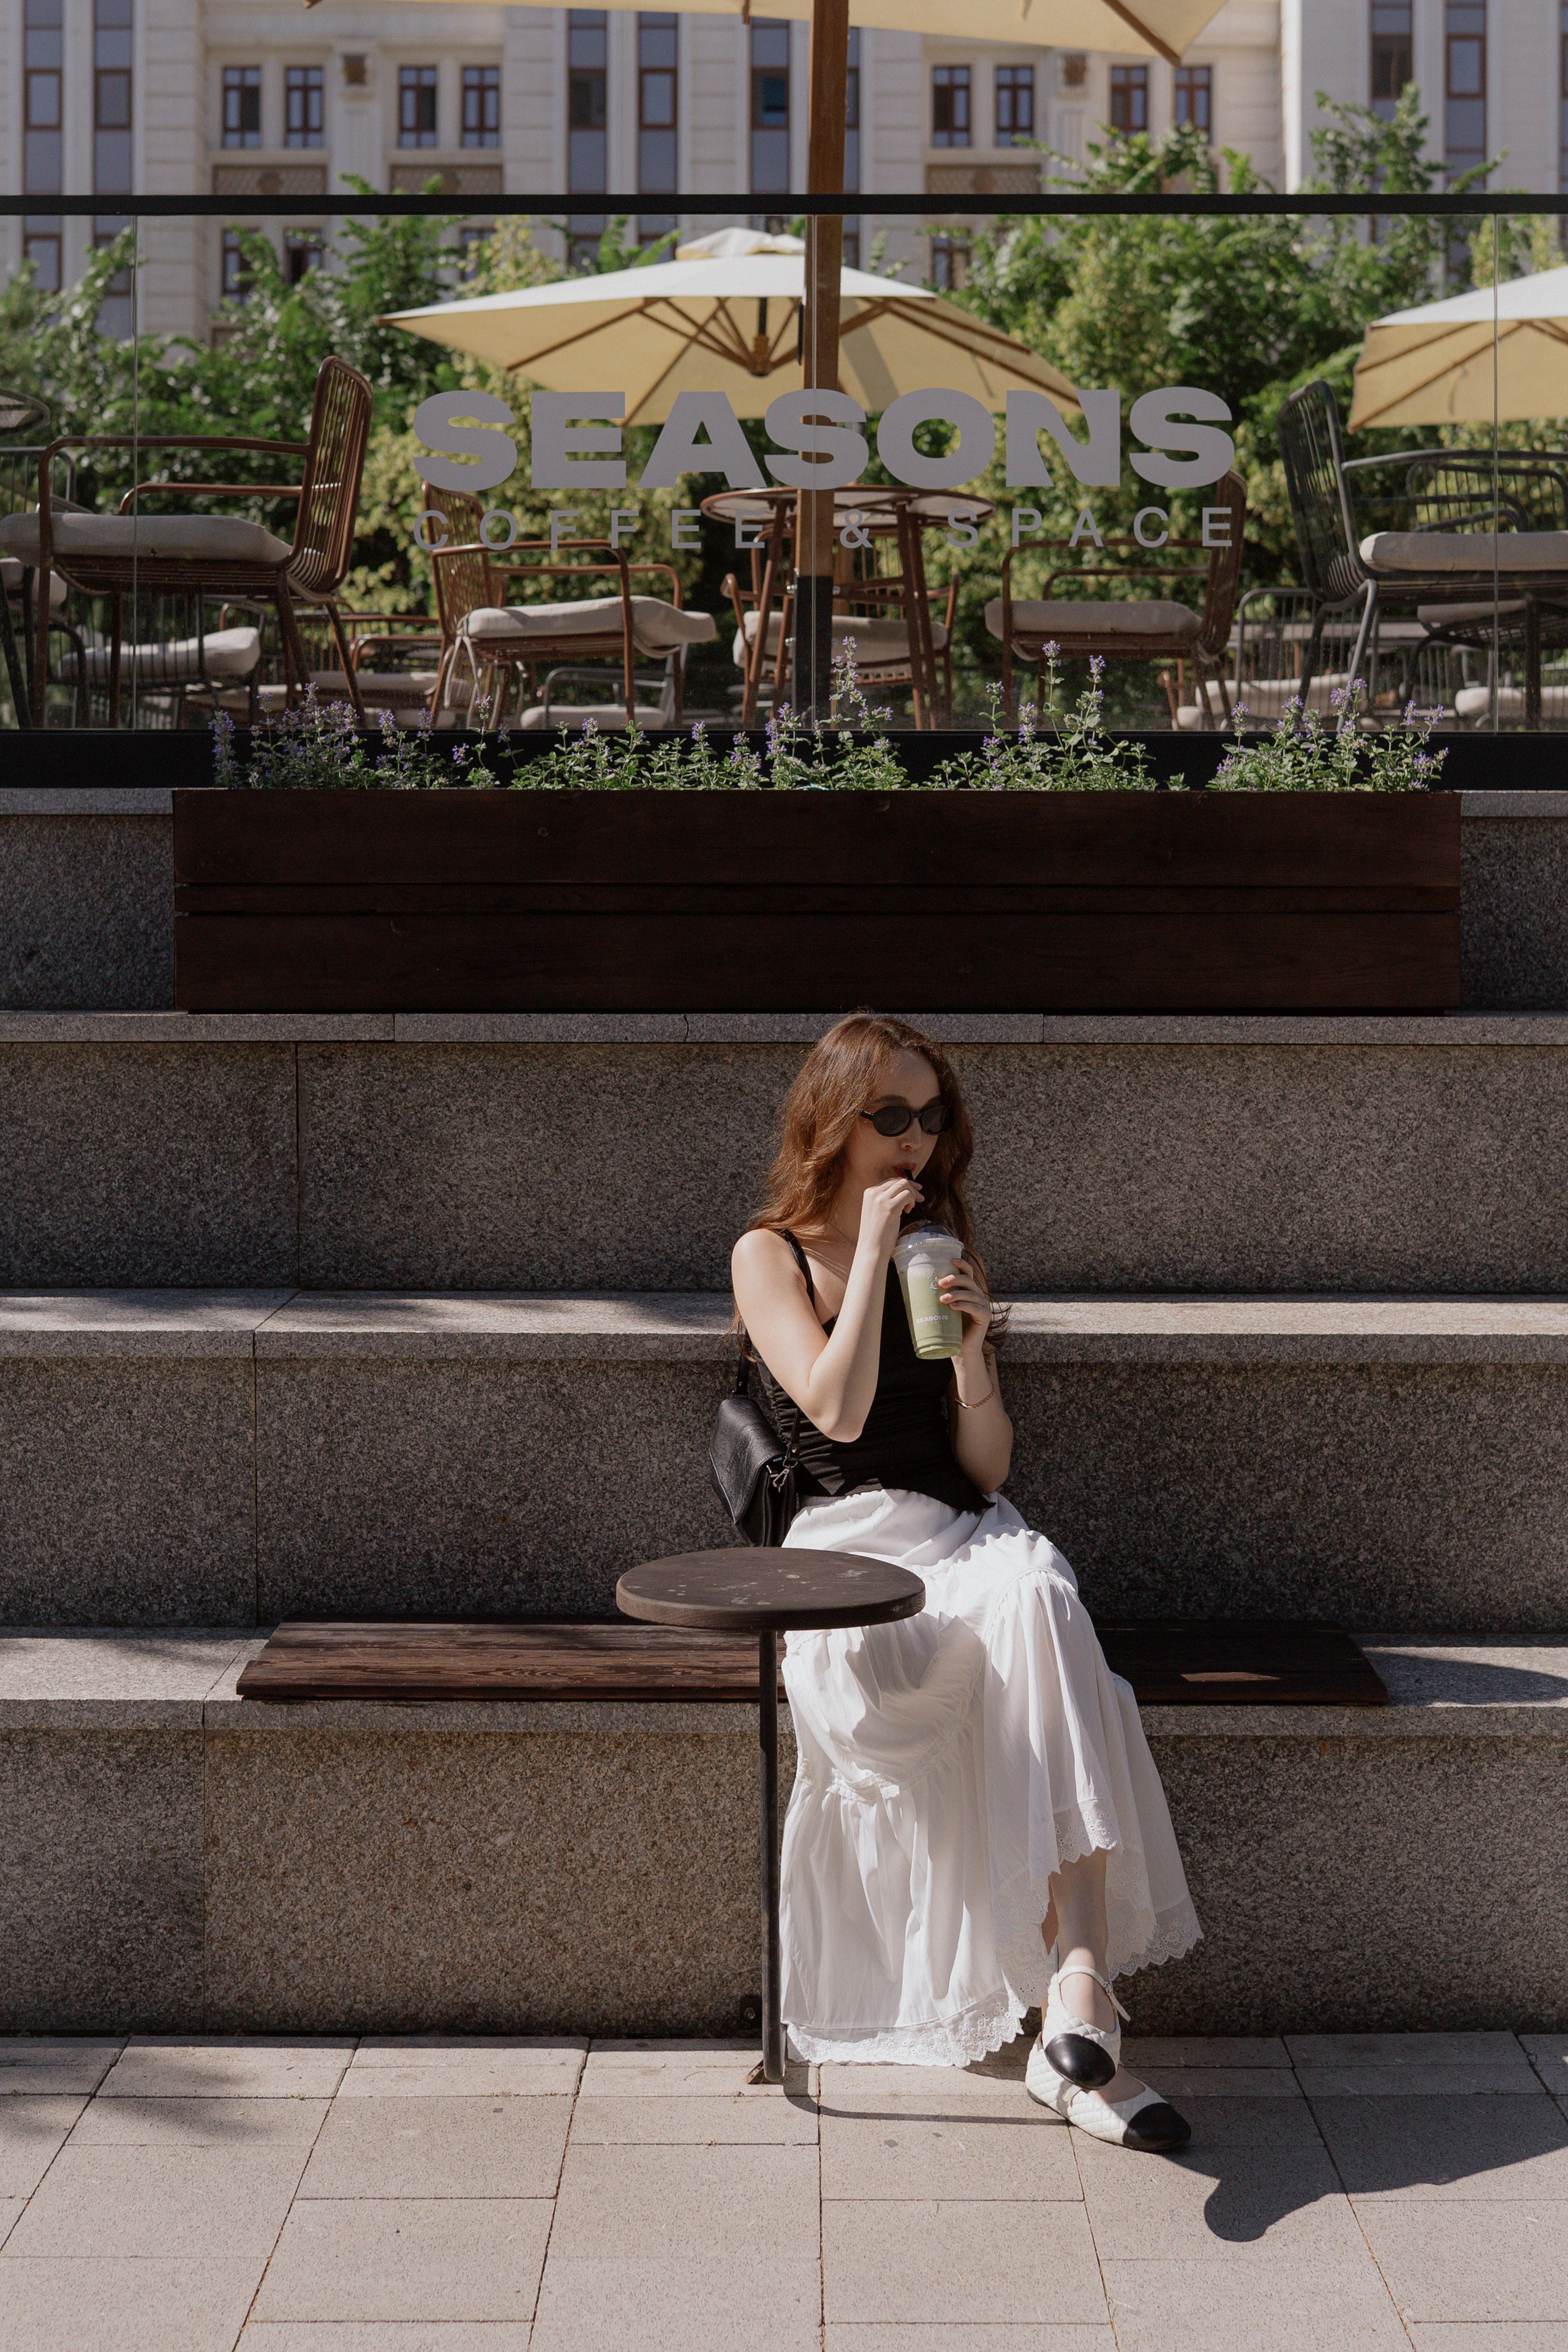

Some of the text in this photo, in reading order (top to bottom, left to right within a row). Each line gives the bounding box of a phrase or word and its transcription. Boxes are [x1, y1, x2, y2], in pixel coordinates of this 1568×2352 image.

[413, 386, 1235, 491] SEASONS
[414, 507, 1232, 550] COFFEE & SPACE
[916, 1314, 949, 1324] SEASONS
